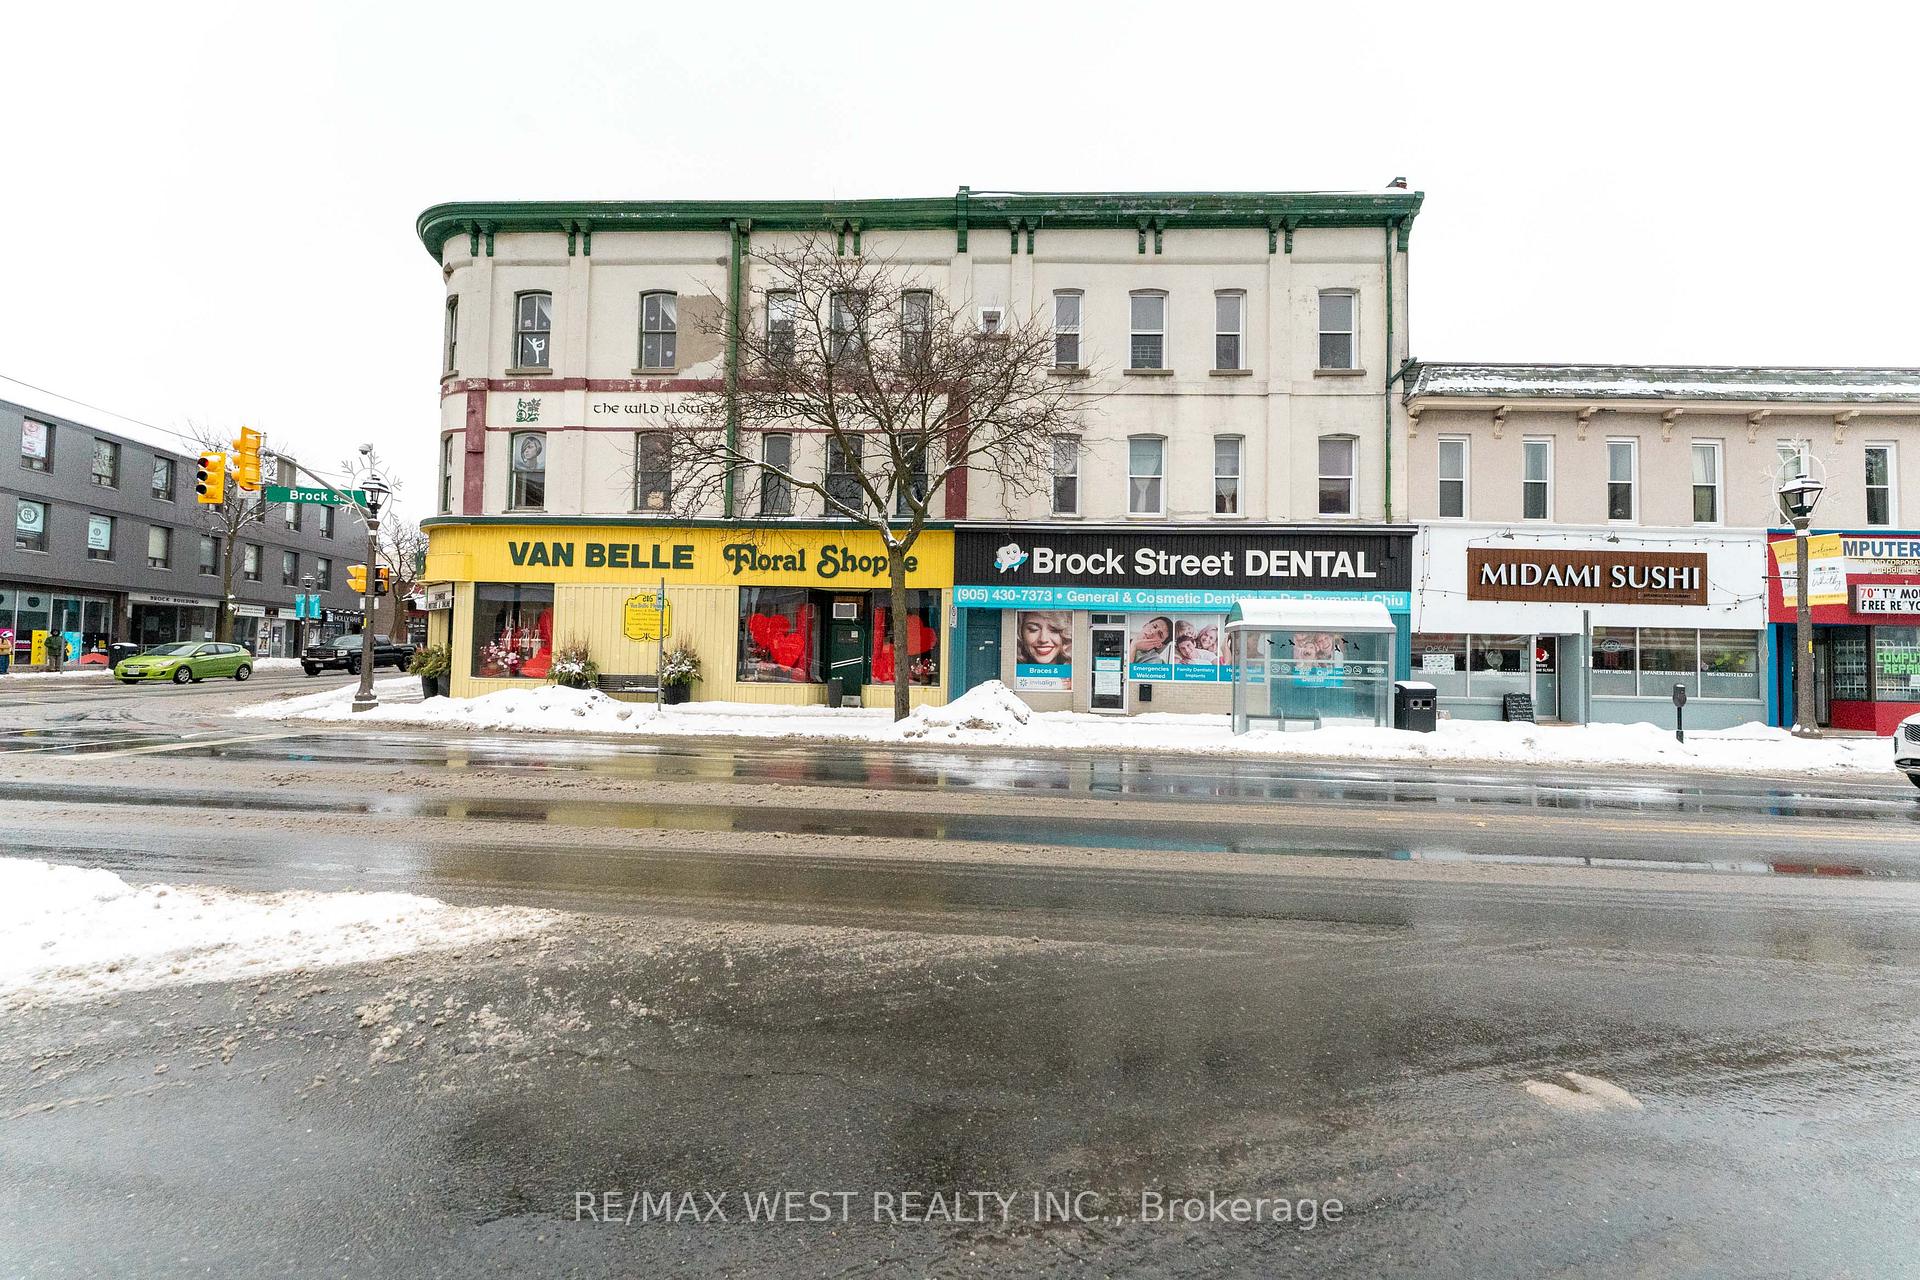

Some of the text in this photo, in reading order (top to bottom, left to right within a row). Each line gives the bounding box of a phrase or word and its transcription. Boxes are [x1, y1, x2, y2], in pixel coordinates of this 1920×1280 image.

[290, 490, 328, 502] Brock
[508, 542, 695, 570] VAN BELLE
[723, 544, 918, 578] Floral Shope
[1033, 547, 1377, 578] Brock Street DENTAL
[1481, 563, 1701, 590] MIDAMI SUSHI
[957, 589, 989, 603] (905)
[992, 590, 1053, 602] 430-7373
[1067, 591, 1119, 603] General
[1123, 592, 1132, 603] &
[1136, 592, 1201, 604] Cosmetic
[1204, 593, 1266, 605] Dentit
[1900, 589, 1920, 599] MO
[1862, 600, 1885, 611] FREE
